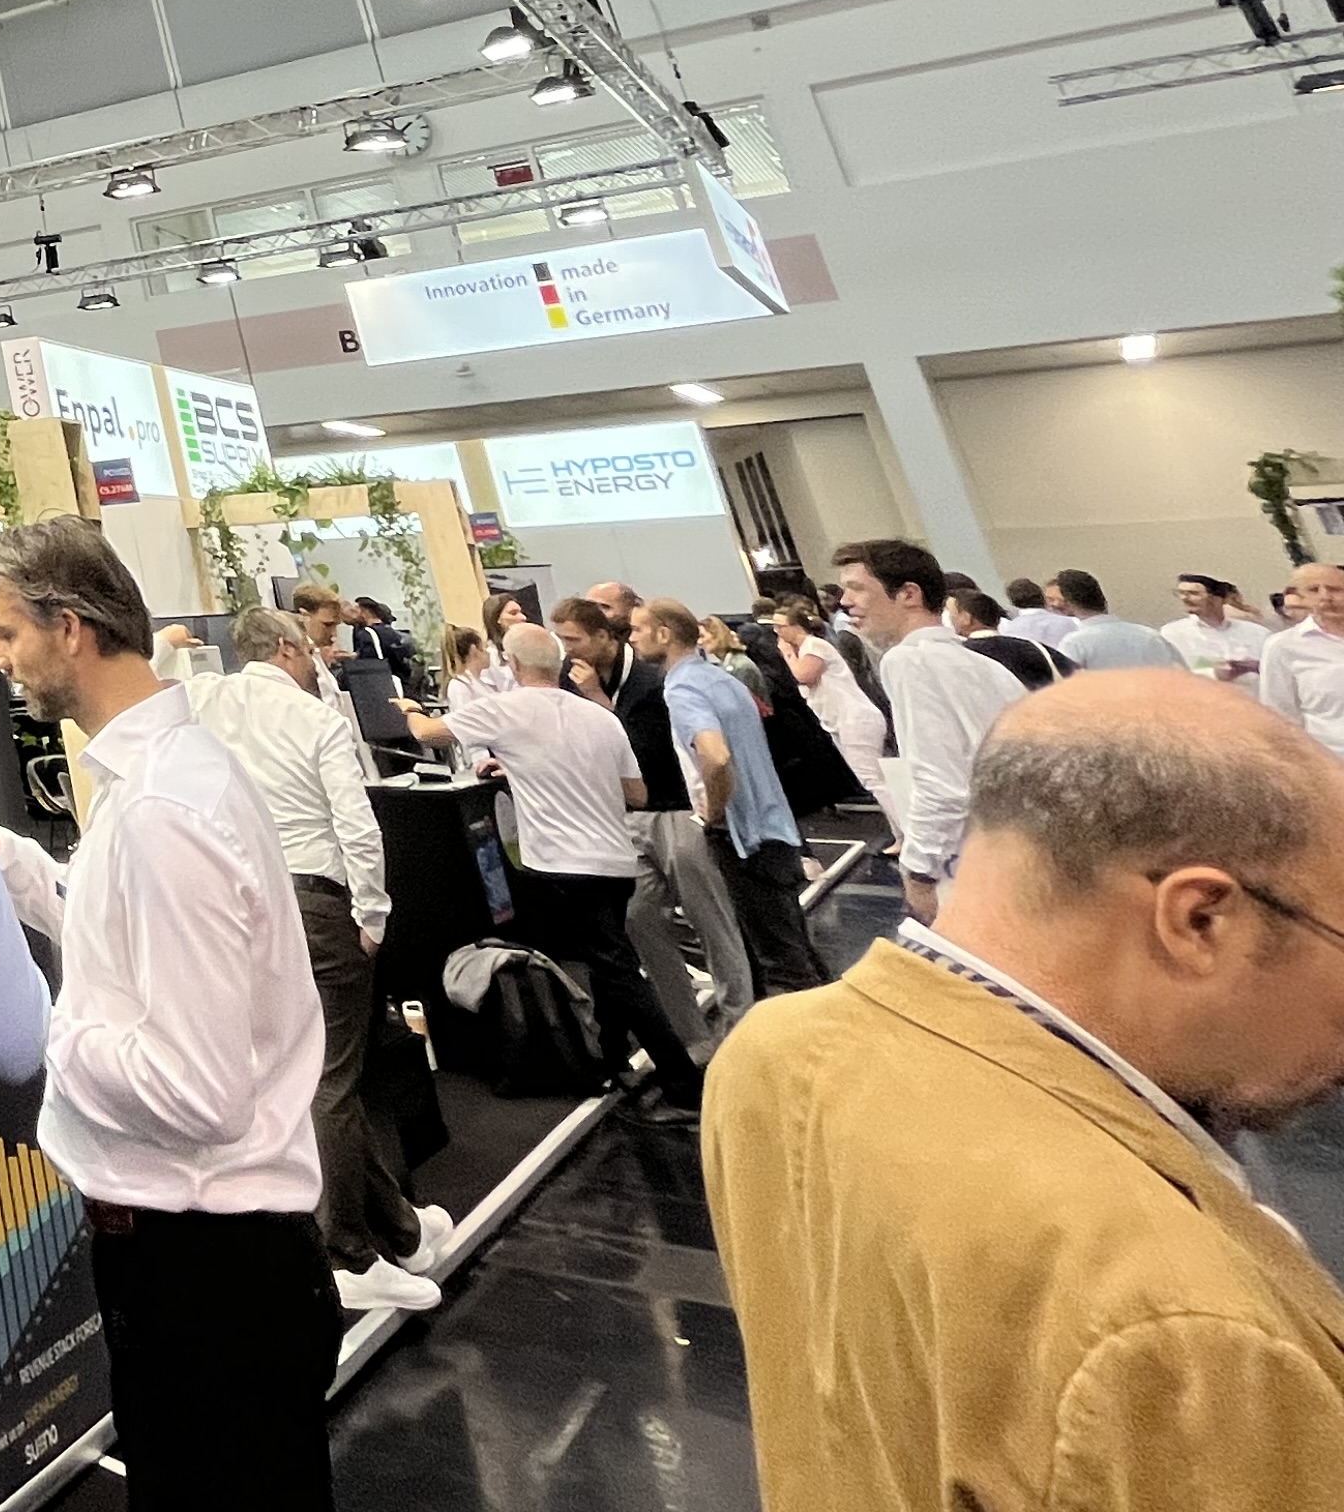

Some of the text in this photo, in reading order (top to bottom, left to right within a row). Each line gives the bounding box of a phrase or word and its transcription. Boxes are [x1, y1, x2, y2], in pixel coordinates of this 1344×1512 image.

[425, 258, 619, 301] Innovation made
[568, 286, 588, 303] in
[576, 301, 671, 325] Germany
[551, 450, 696, 477] HYPOSTO
[556, 472, 674, 496] ENERGY
